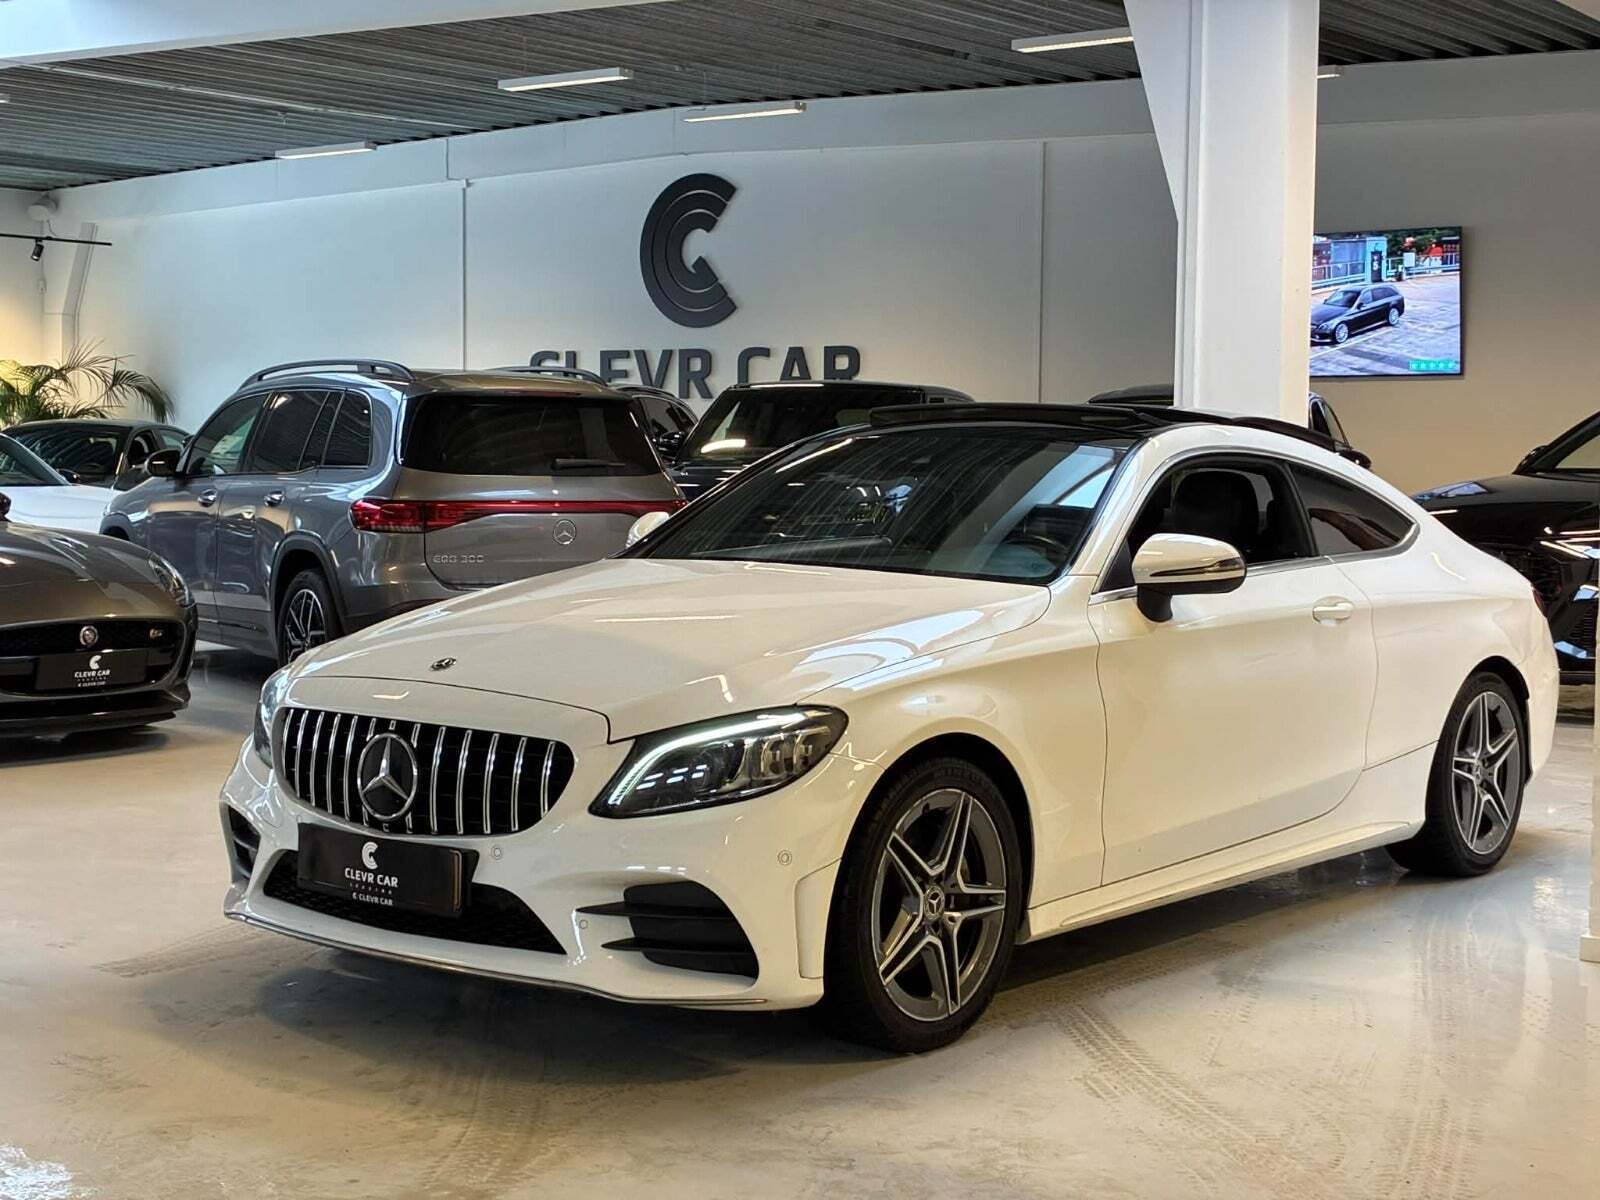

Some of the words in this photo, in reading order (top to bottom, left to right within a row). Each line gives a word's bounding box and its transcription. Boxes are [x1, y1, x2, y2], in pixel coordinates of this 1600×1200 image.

[737, 345, 861, 385] CAR
[344, 867, 375, 884] CLEVR
[377, 874, 399, 888] CAR
